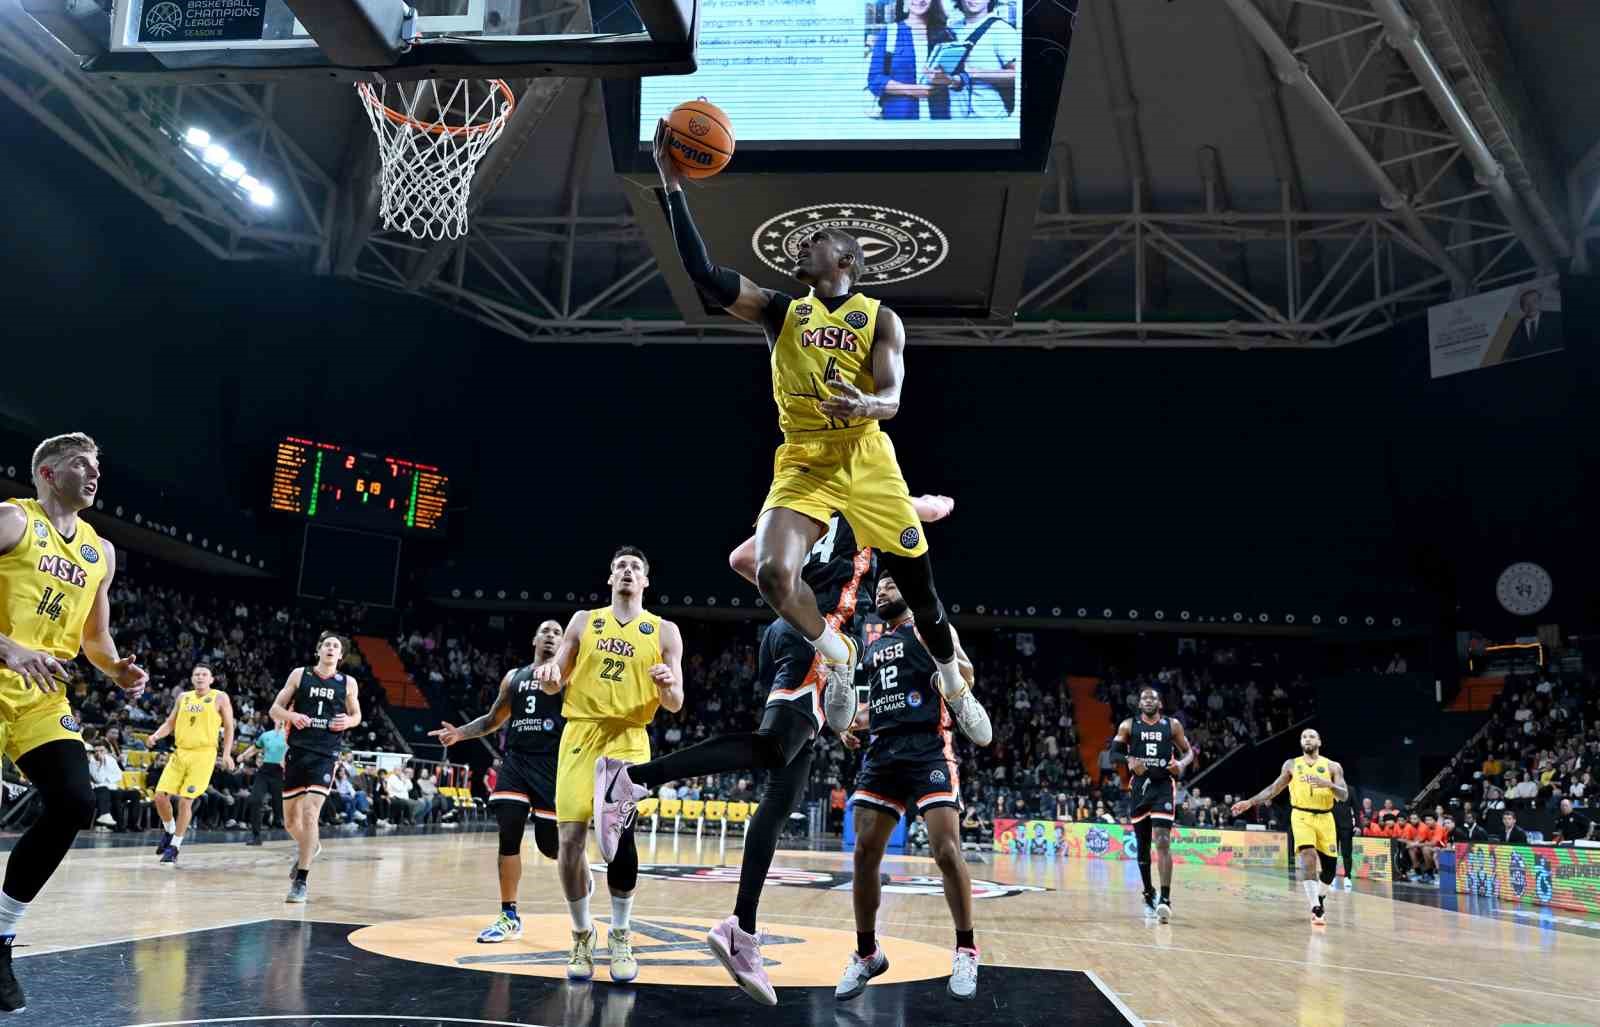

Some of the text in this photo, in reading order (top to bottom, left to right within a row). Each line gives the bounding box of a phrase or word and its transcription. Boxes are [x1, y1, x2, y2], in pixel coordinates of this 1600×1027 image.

[186, 7, 260, 18] CHAMPIONS
[184, 18, 225, 27] LEAGUE
[699, 35, 732, 46] ocation
[801, 326, 858, 352] MSK
[345, 455, 356, 469] 2
[390, 464, 399, 478] 7
[39, 555, 88, 588] MSK
[36, 586, 65, 621] 14
[597, 638, 635, 658] MSK
[873, 642, 905, 667] MSB
[599, 657, 626, 682] 22
[880, 665, 899, 690] 12
[309, 686, 335, 700] MSB
[518, 680, 543, 693] MS
[317, 700, 324, 716] 1
[524, 695, 537, 714] 3
[875, 701, 906, 714] LE MANS
[1140, 731, 1163, 742] MSB
[1145, 743, 1158, 757] 15
